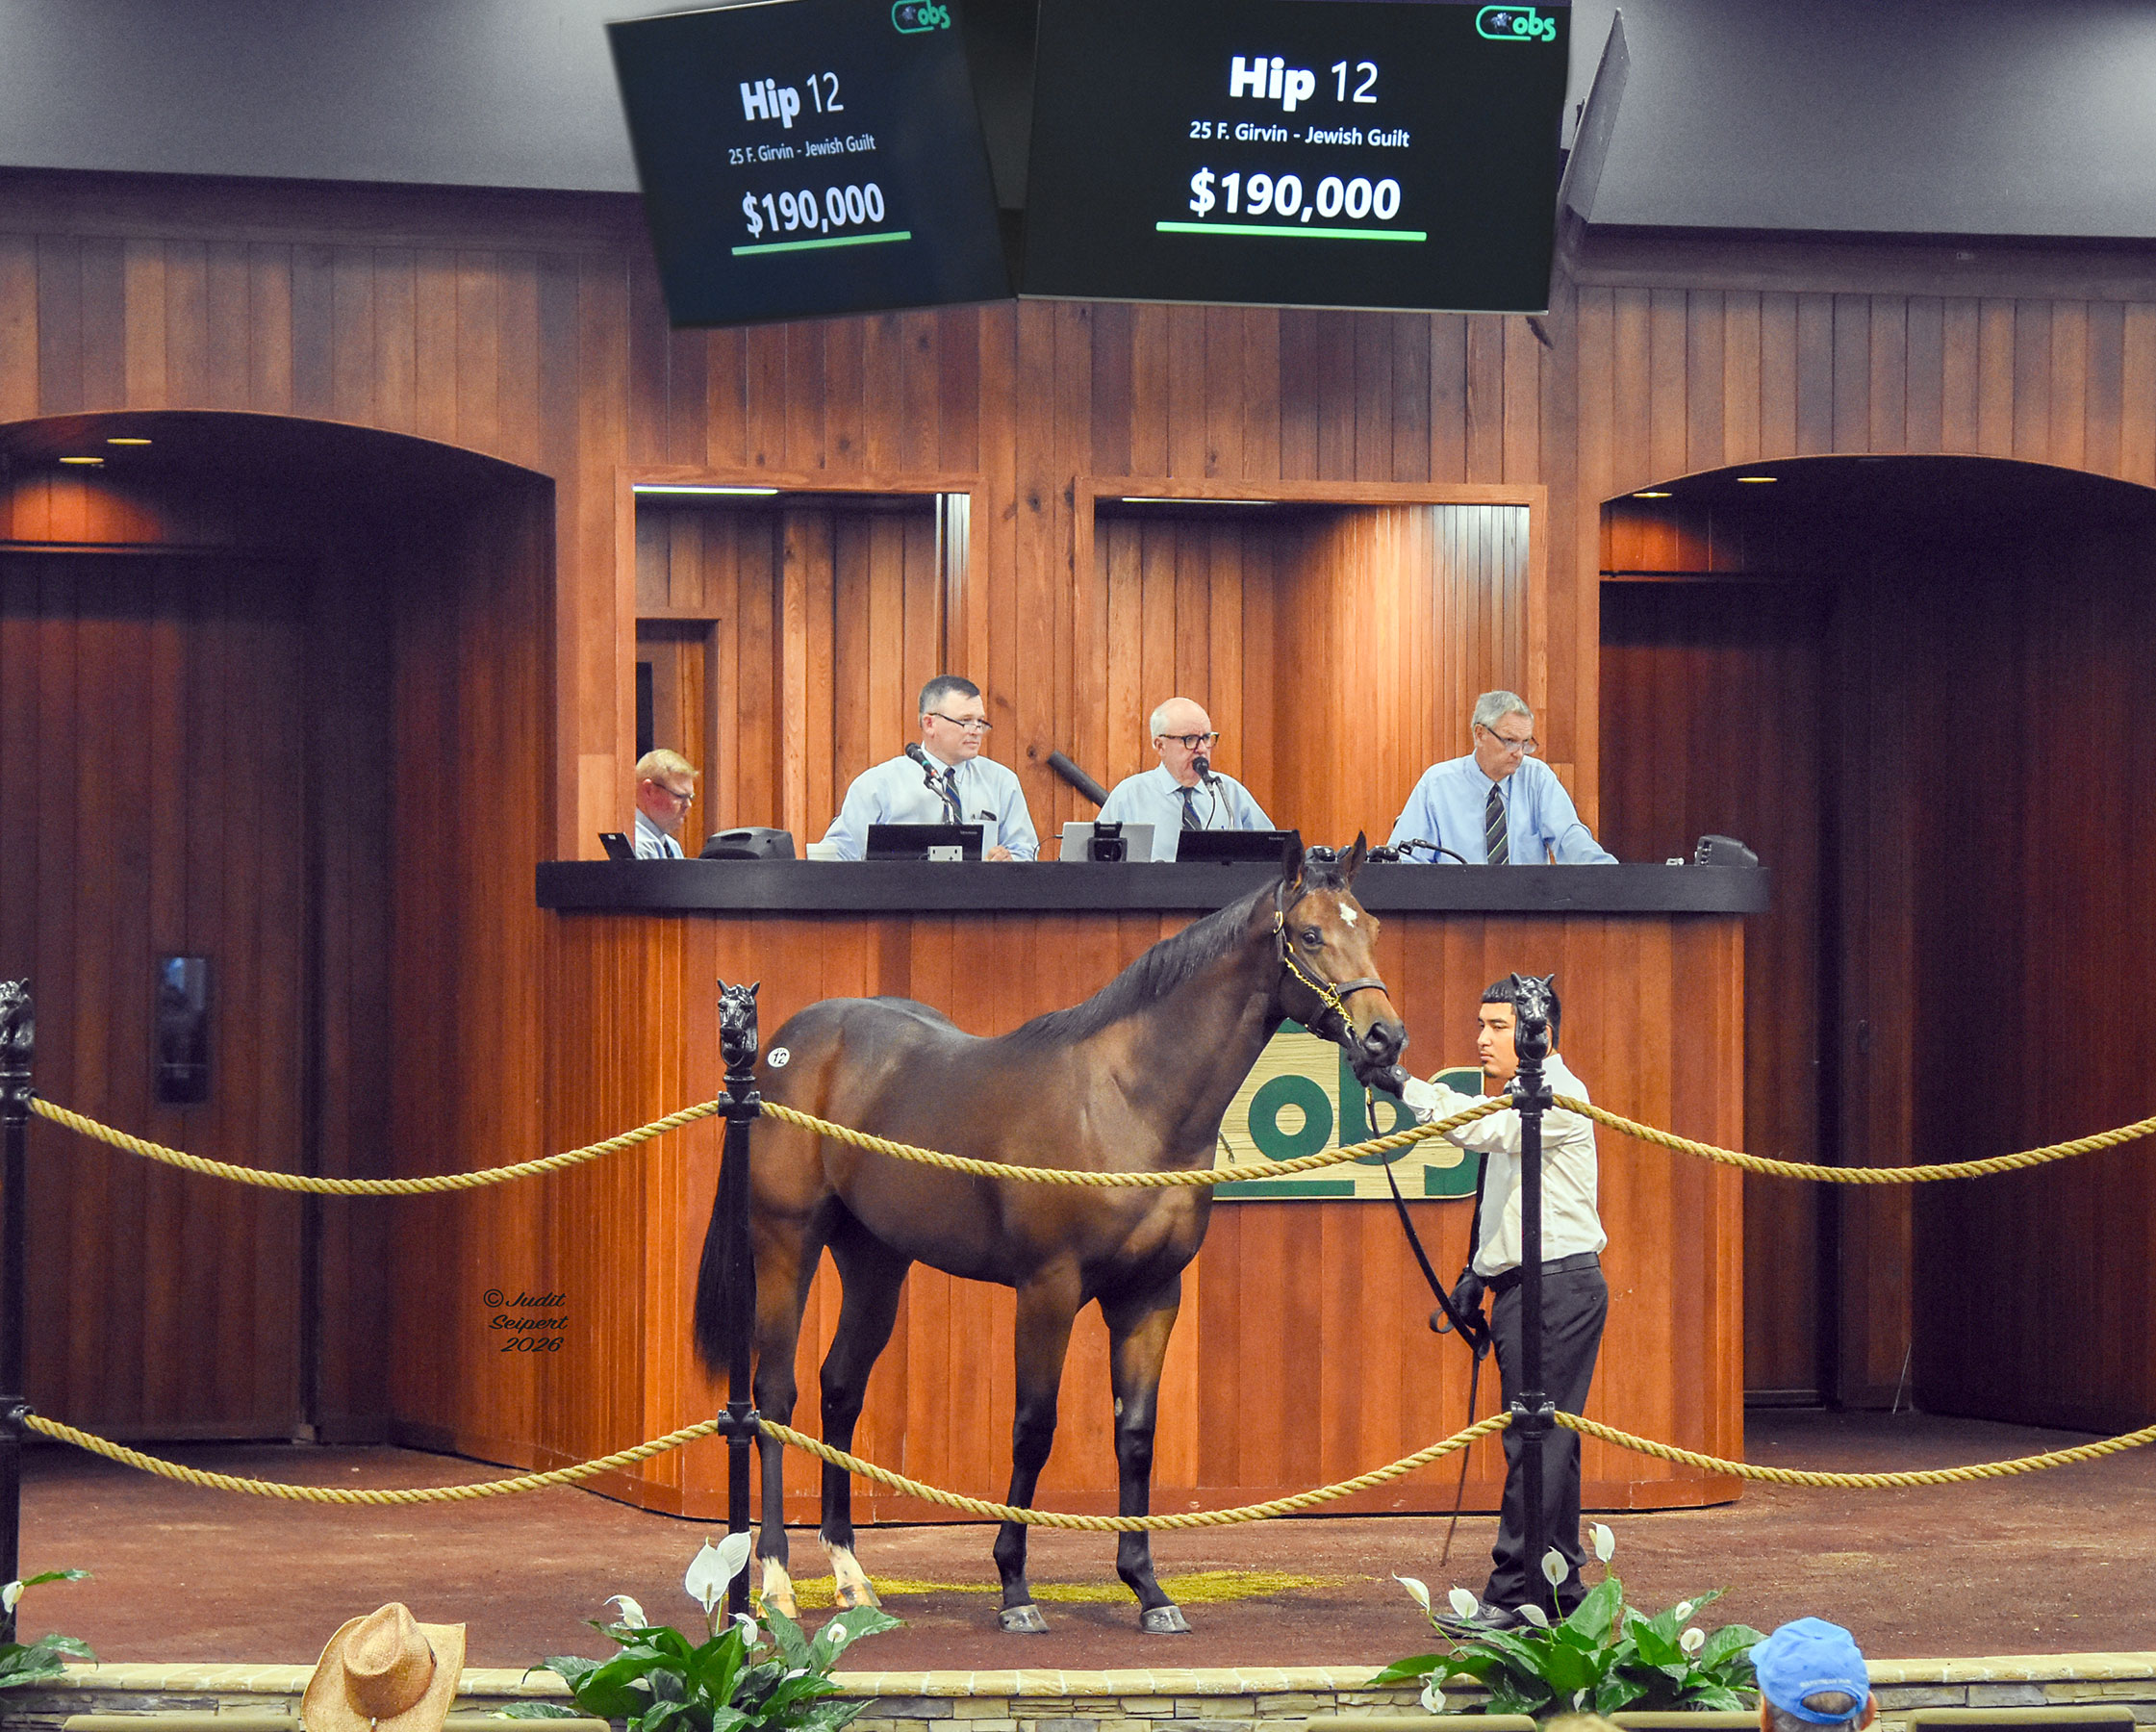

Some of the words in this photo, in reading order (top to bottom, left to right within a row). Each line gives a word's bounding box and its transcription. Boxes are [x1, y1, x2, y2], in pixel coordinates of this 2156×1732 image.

[918, 2, 951, 29] obs
[1512, 8, 1557, 41] obs
[740, 78, 800, 128] Hip
[806, 72, 844, 114] 12
[1229, 56, 1316, 112] Hip
[1331, 62, 1378, 104] 12
[728, 148, 744, 165] 25
[746, 146, 756, 163] F.
[758, 142, 794, 162] Girvin
[805, 137, 844, 157] Jewish
[846, 133, 876, 152] Guilt
[1189, 121, 1211, 140] 25
[1216, 122, 1230, 140] F.
[1234, 123, 1288, 142] Girvin
[1305, 126, 1362, 145] Jewish
[1367, 129, 1409, 147] Guilt
[742, 183, 885, 239] $190,000
[1189, 167, 1401, 222] $190,000
[773, 1052, 787, 1064] 12
